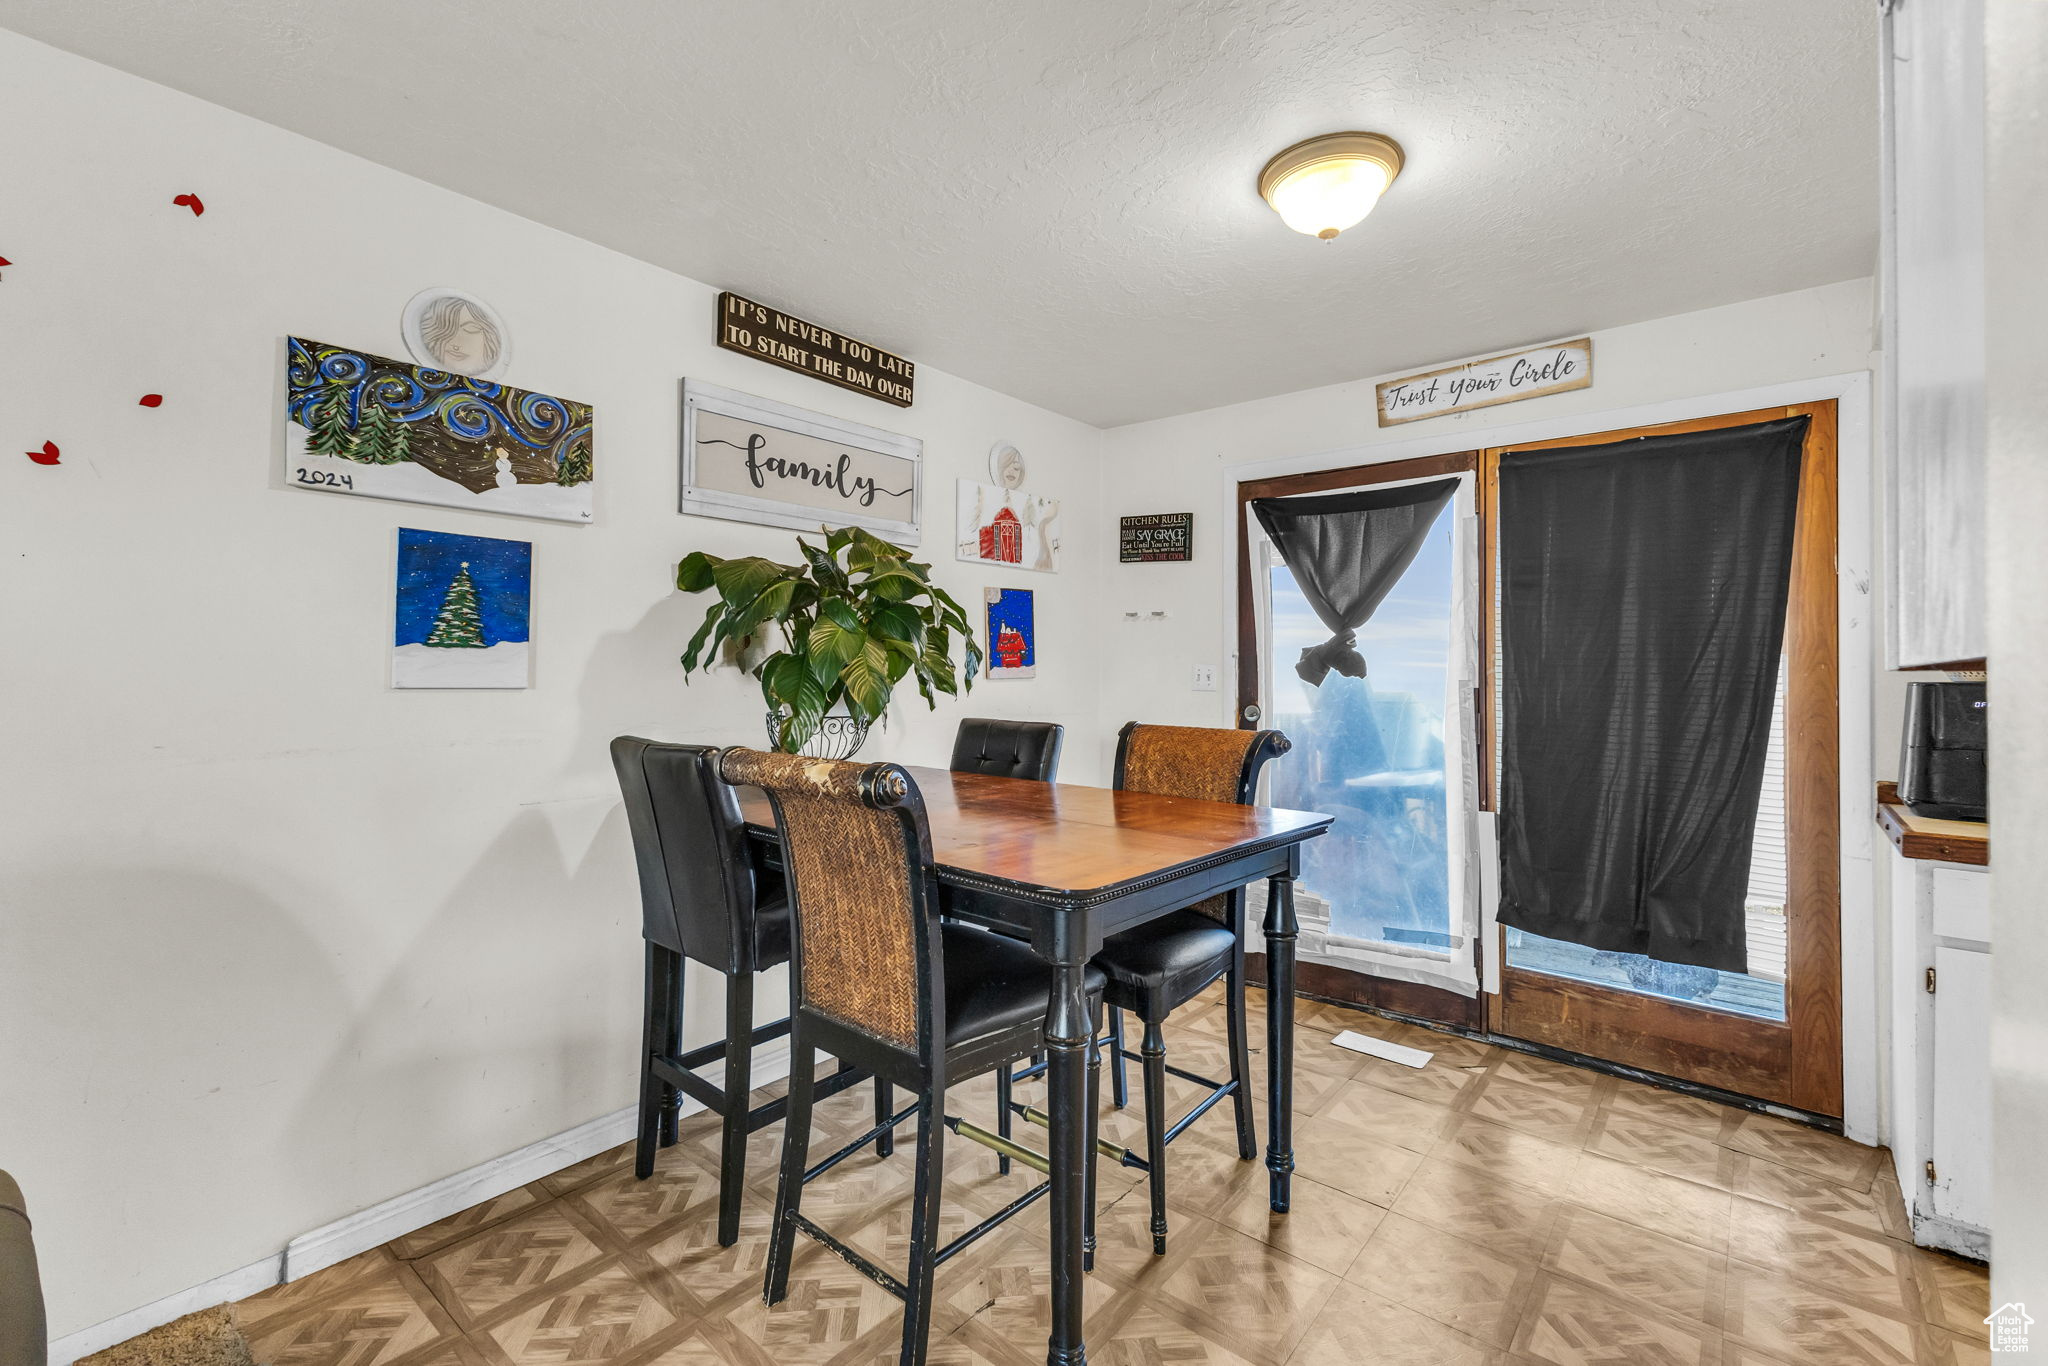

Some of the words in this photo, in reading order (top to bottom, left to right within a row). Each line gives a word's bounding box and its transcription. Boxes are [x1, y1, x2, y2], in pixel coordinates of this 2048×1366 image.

[729, 296, 768, 325] IT'S
[776, 313, 832, 349] NEVER
[839, 337, 872, 363] TOO
[878, 353, 913, 379] LATE
[728, 324, 752, 347] TO
[757, 335, 809, 366] START
[813, 354, 842, 378] THE
[847, 366, 874, 389] DAY
[877, 378, 912, 403] OVER
[1389, 378, 1439, 410] Trust
[1509, 350, 1576, 387] Circle
[296, 468, 353, 490] 2024
[745, 433, 875, 507] family
[1122, 516, 1159, 526] KITCHEN
[1161, 513, 1187, 524] RULES
[1136, 529, 1153, 541] SAY
[1154, 528, 1185, 541] GRACE
[1122, 541, 1132, 549] Eat
[1133, 540, 1150, 548] Until
[1151, 540, 1170, 548] You're
[1170, 538, 1184, 547] Full
